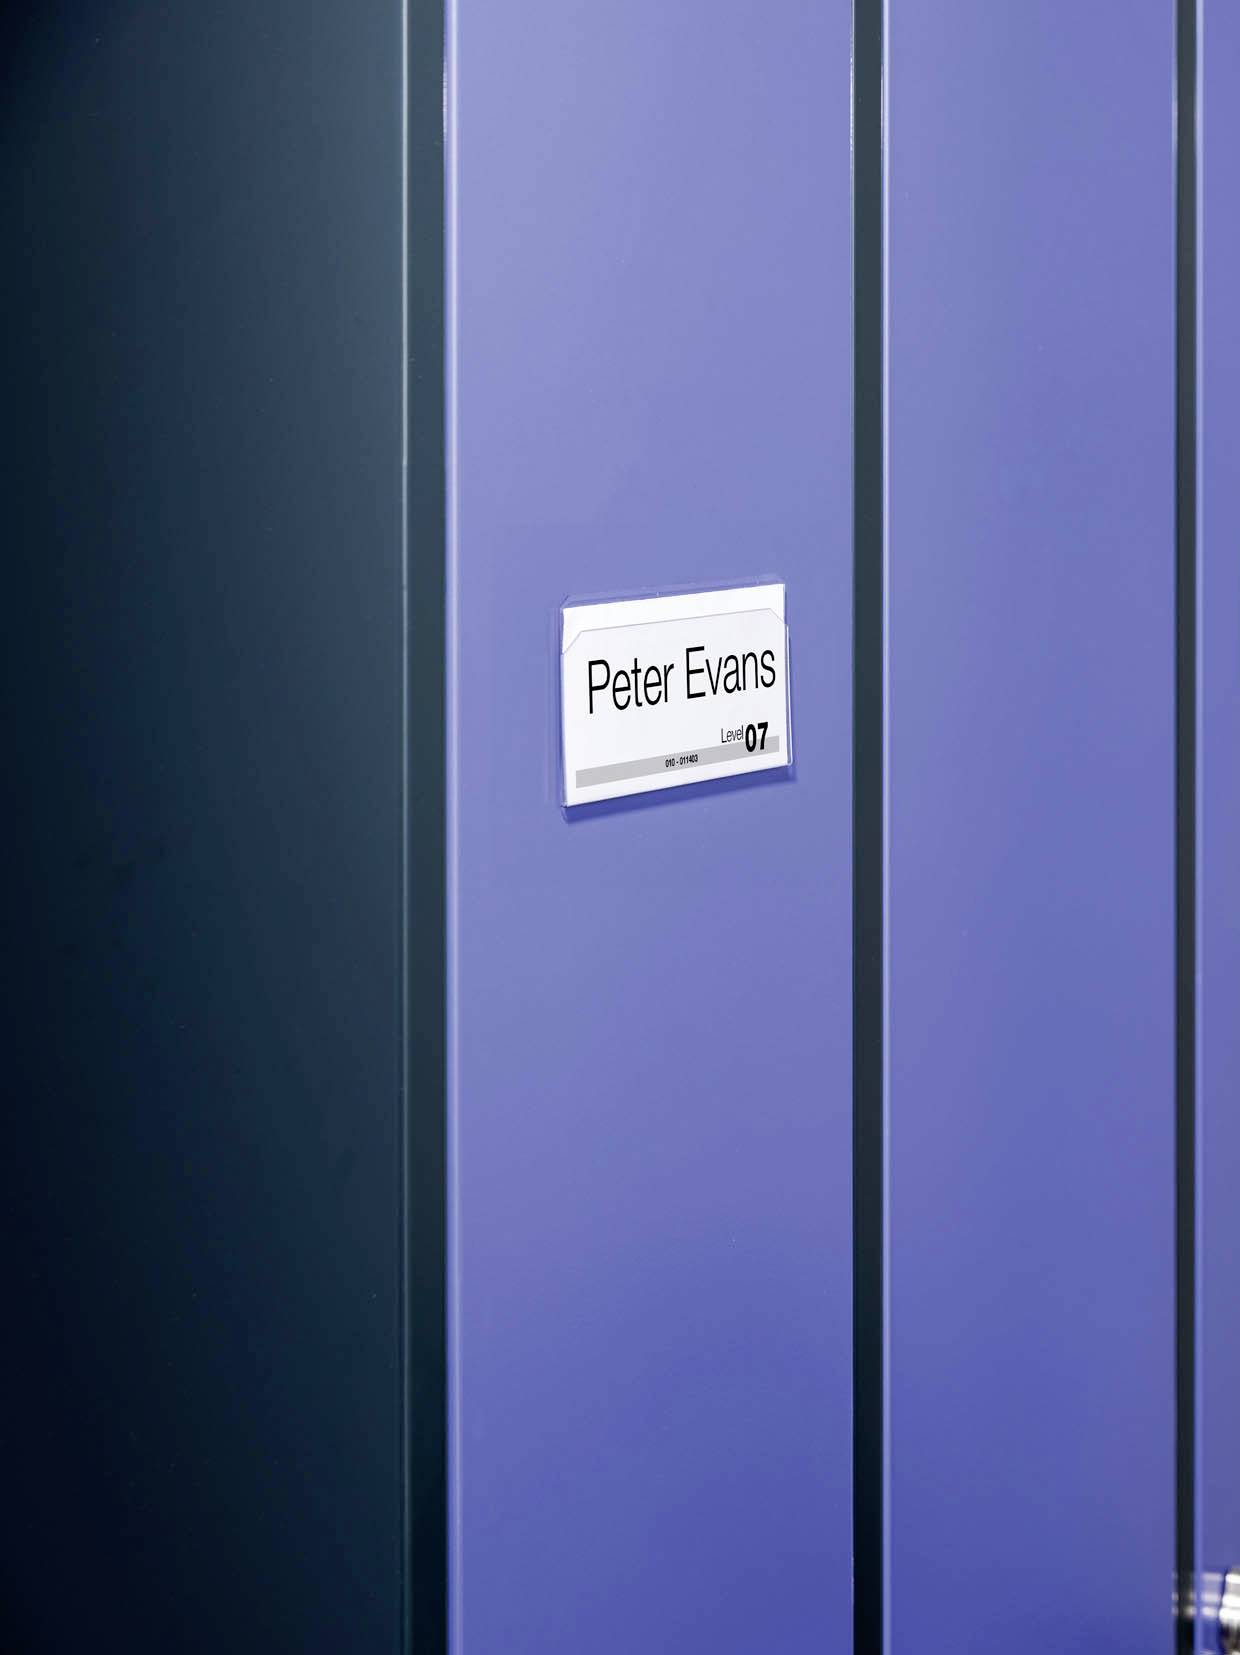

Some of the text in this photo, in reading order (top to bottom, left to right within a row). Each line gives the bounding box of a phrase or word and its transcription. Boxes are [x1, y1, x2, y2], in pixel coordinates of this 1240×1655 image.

[588, 645, 776, 714] Peter Evans
[721, 721, 769, 752] Level 07
[665, 758, 675, 768] 010
